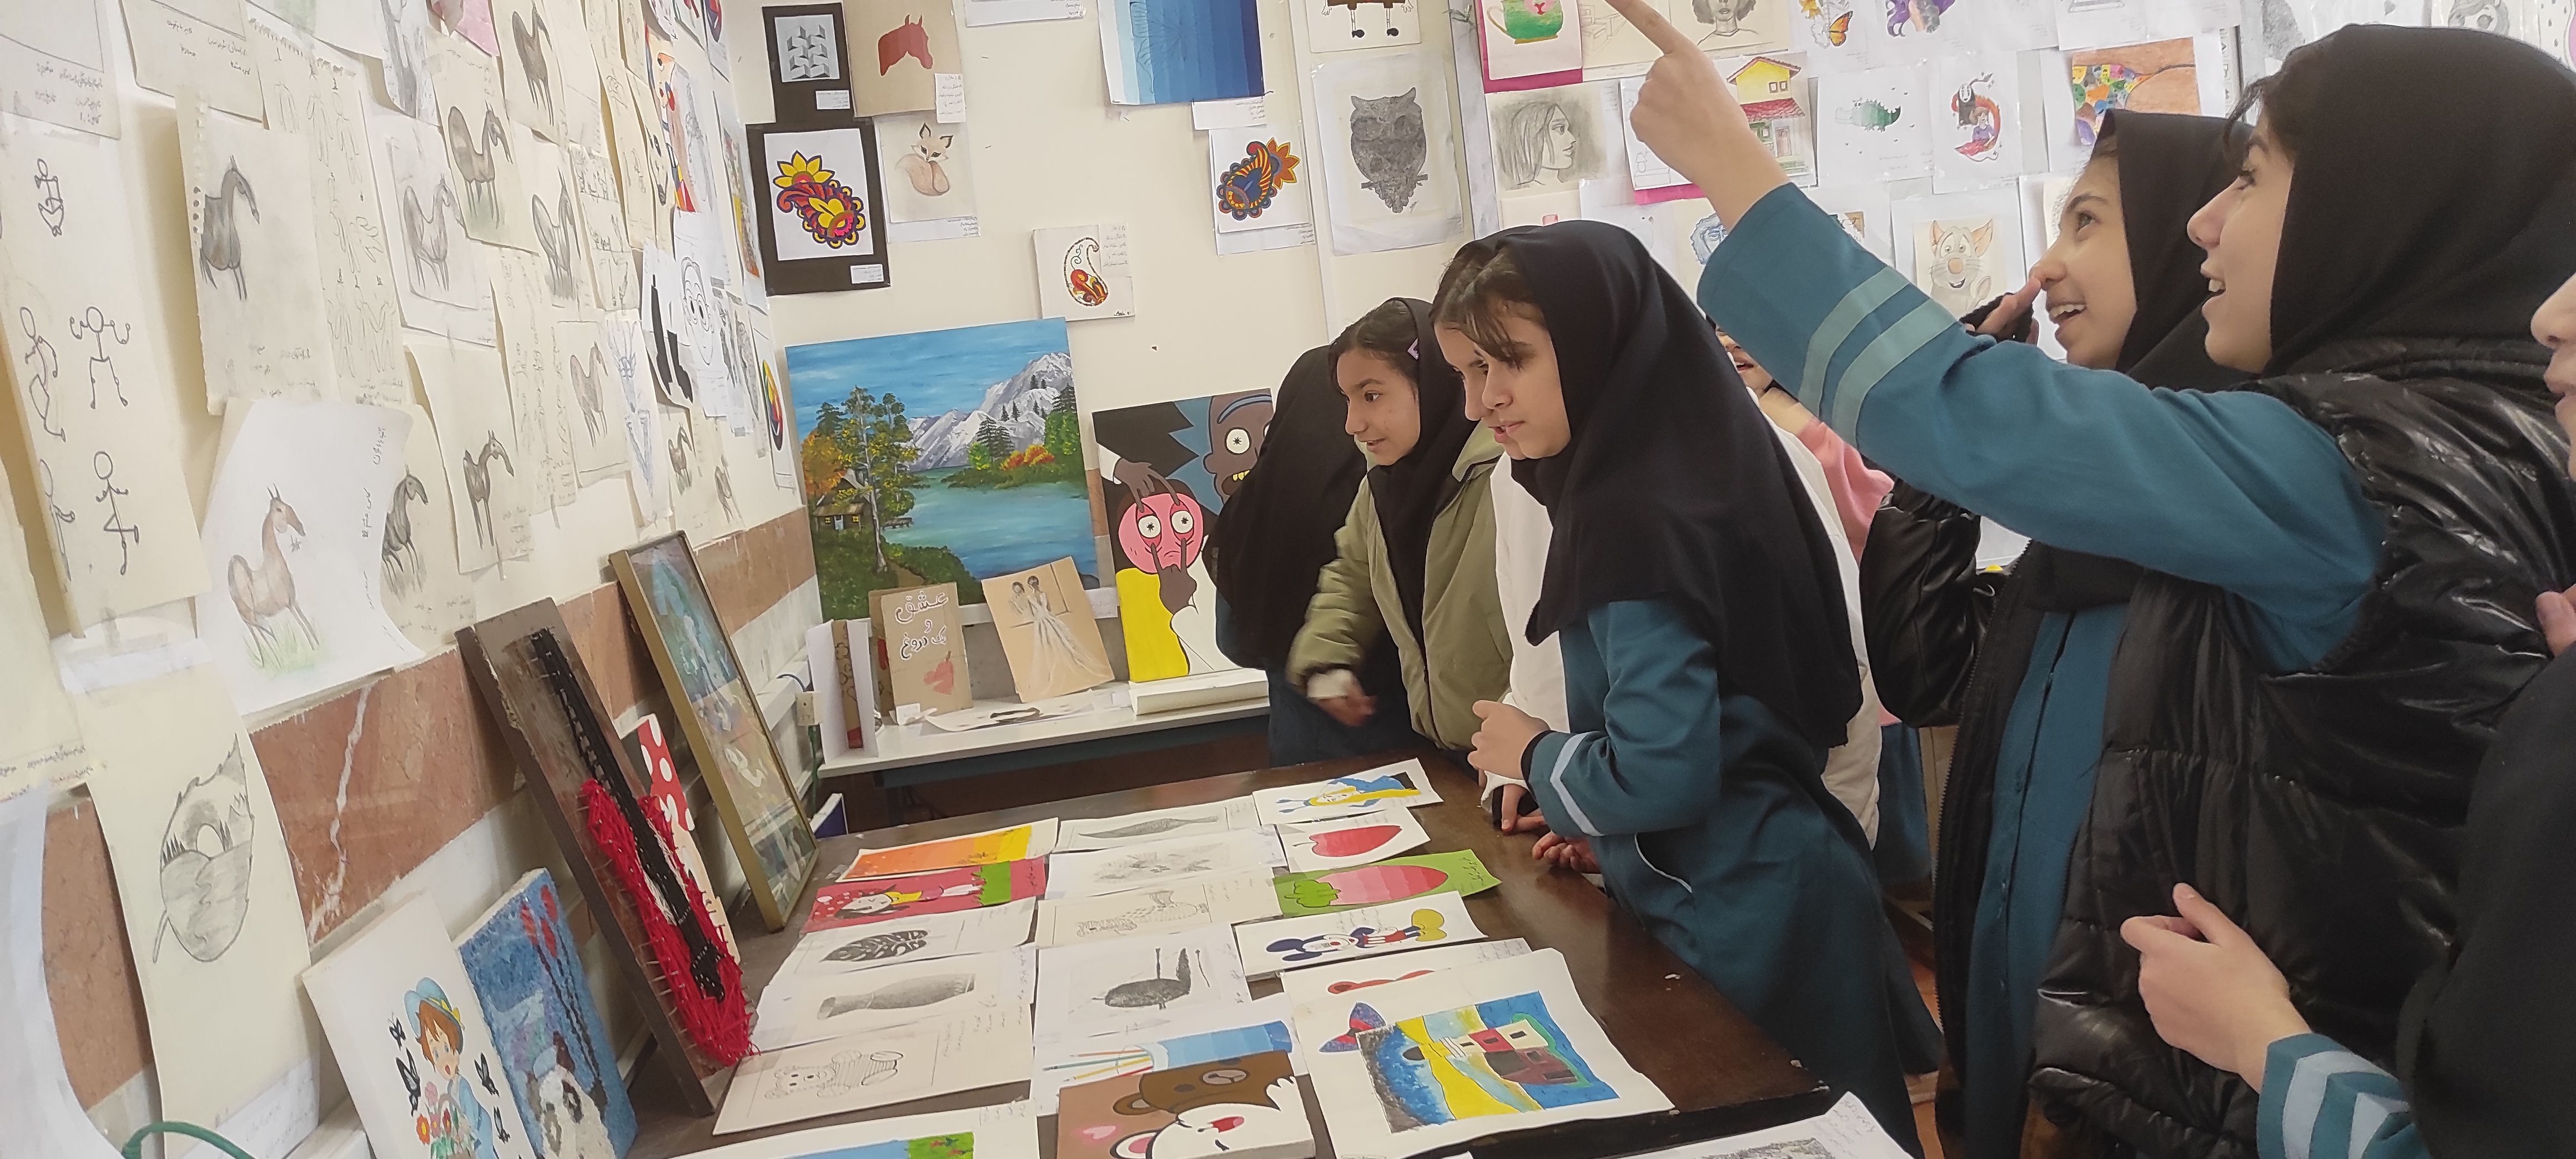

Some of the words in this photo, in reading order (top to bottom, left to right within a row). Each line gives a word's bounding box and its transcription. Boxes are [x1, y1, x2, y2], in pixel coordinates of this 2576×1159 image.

[895, 591, 949, 624] عشق
[924, 619, 933, 633] و
[931, 625, 946, 644] یک
[900, 632, 928, 661] دروغ
